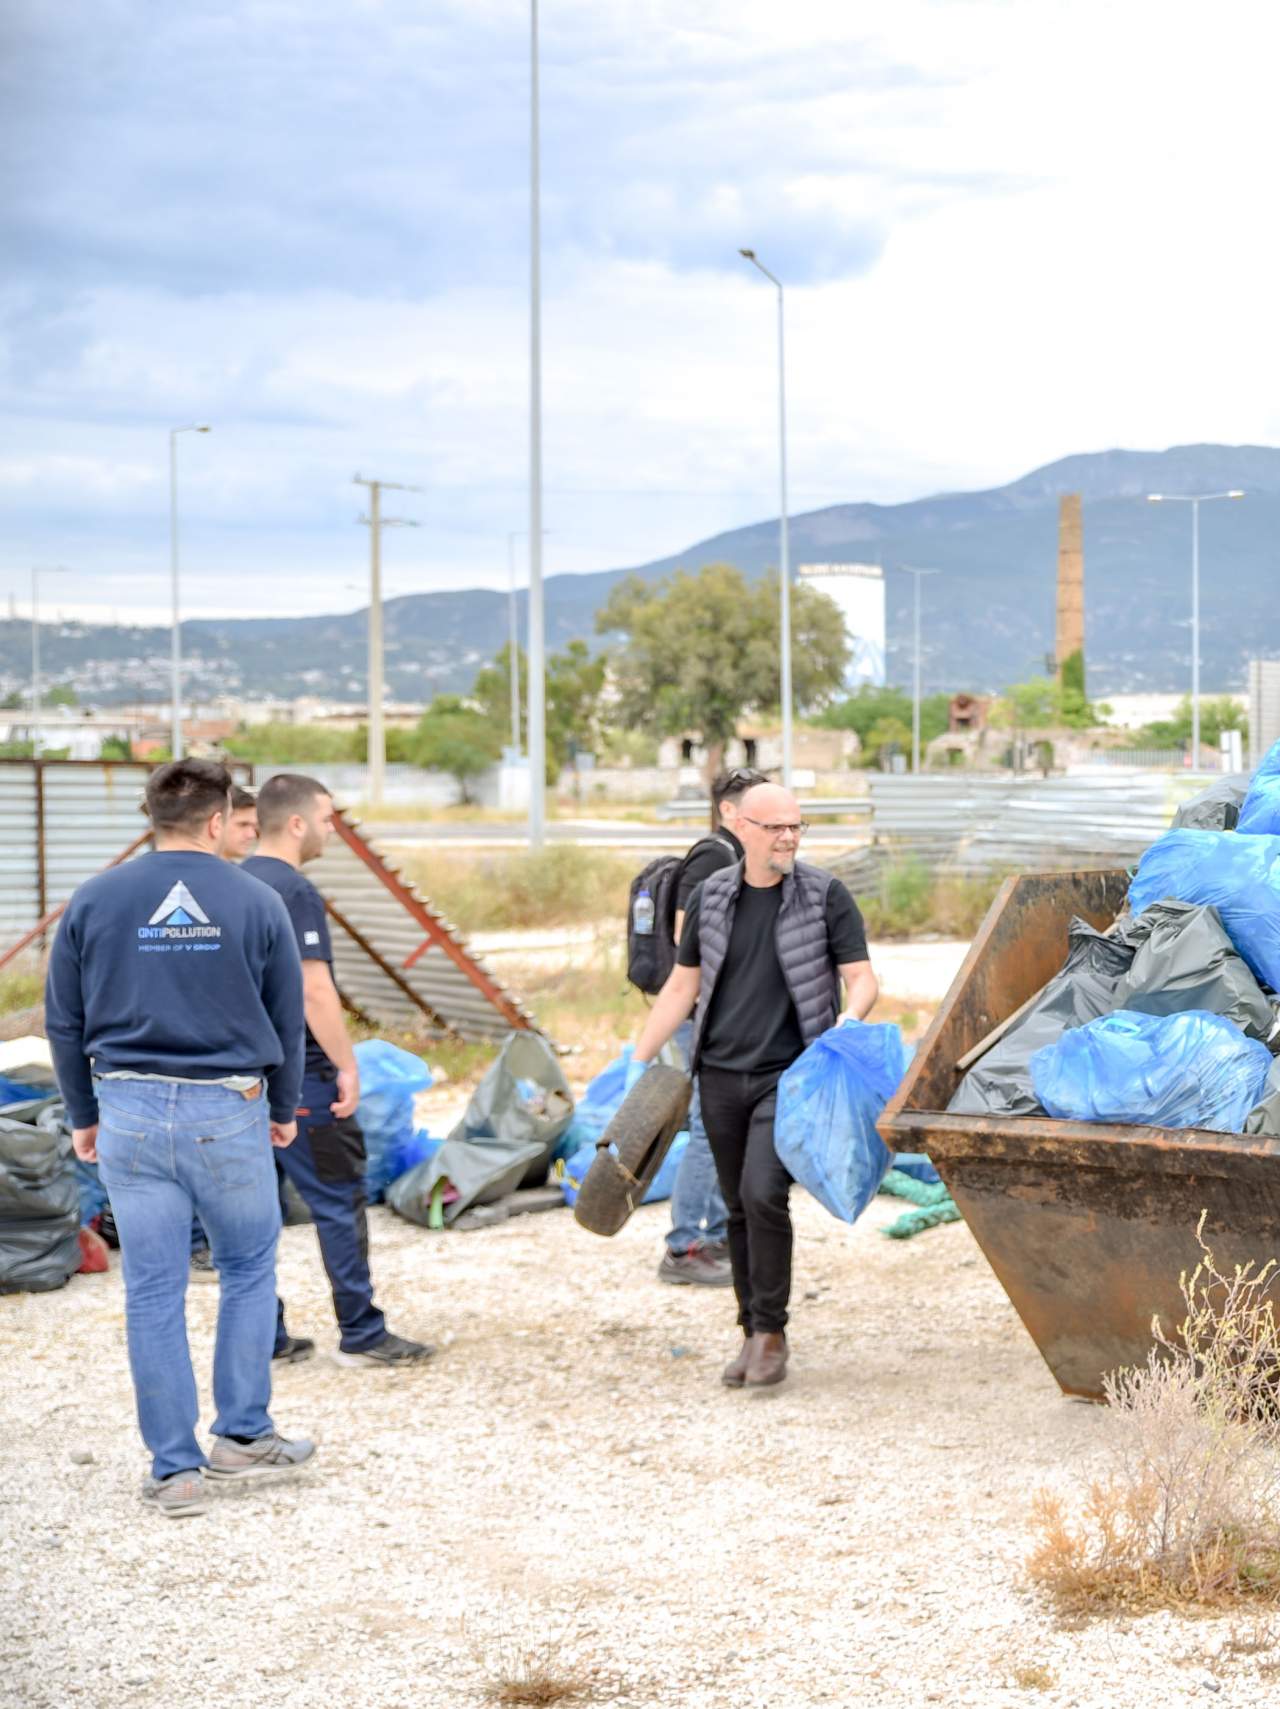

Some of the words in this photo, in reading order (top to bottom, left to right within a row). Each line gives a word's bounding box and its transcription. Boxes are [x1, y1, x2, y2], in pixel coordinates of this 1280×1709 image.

[138, 944, 171, 953] MEMBER
[173, 944, 183, 952] OF
[193, 943, 222, 952] GROUP
